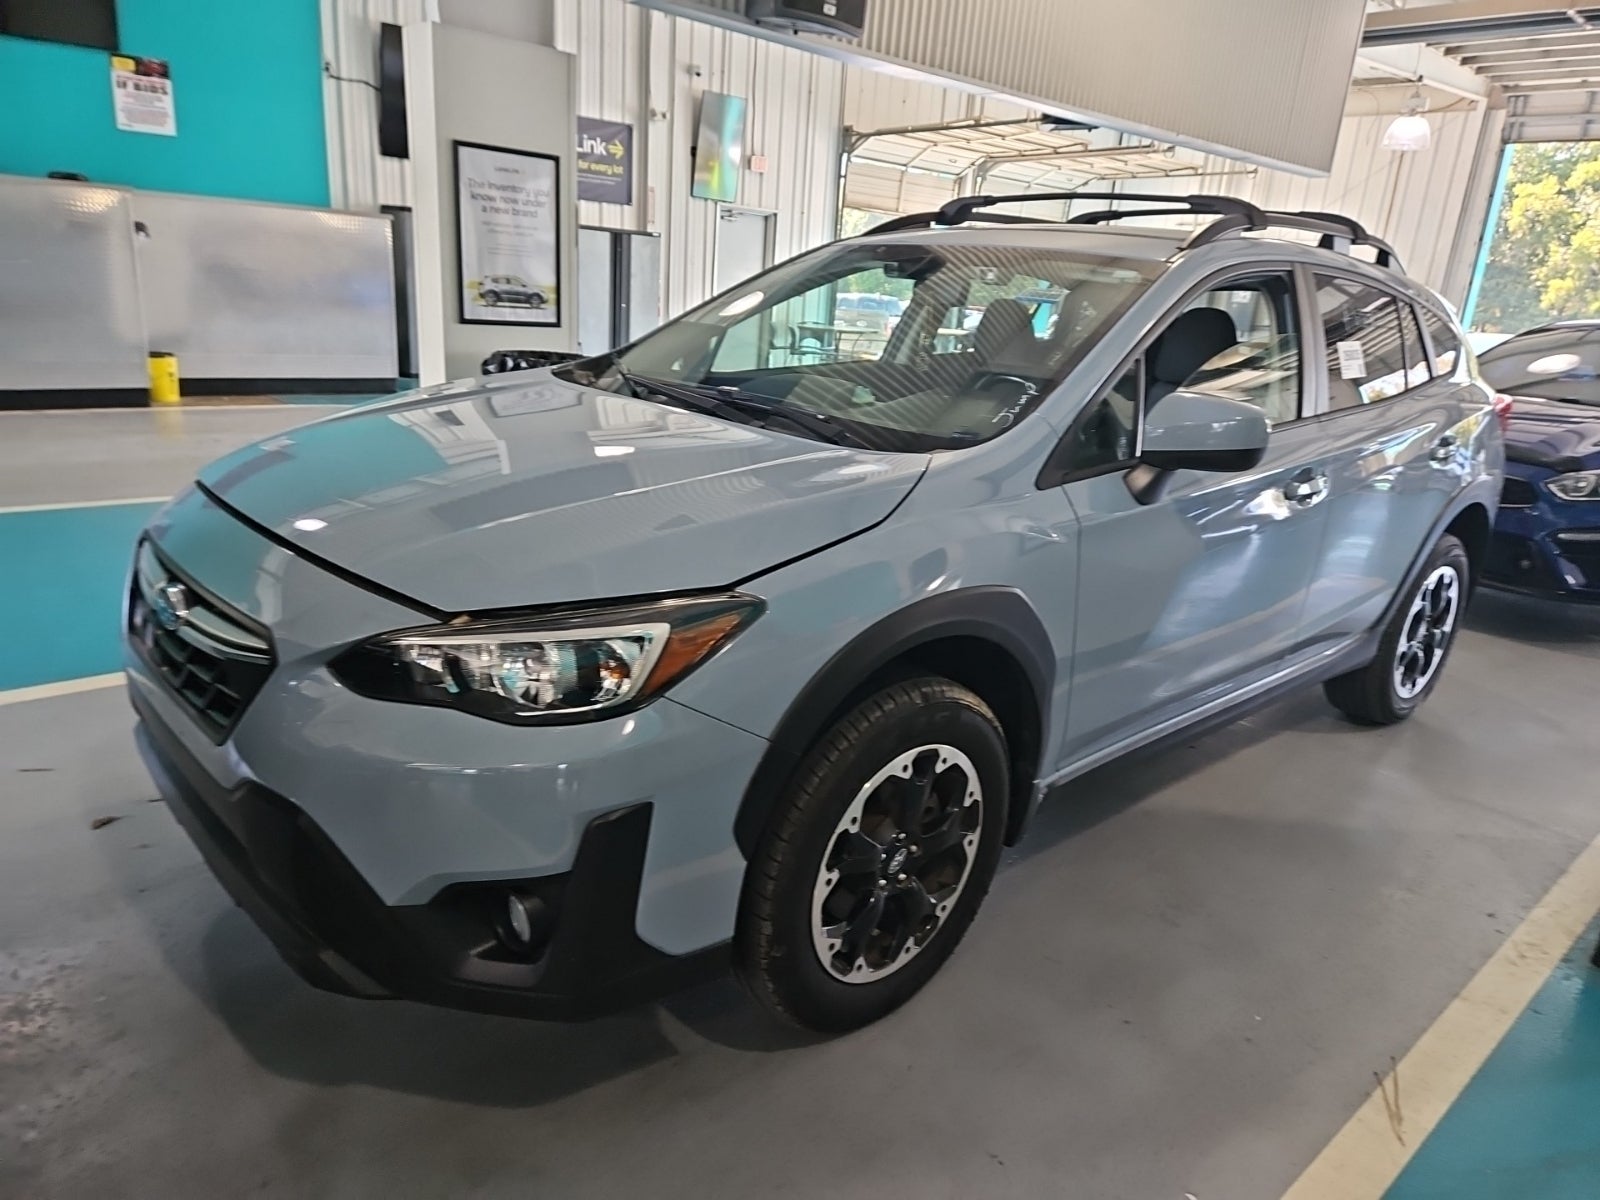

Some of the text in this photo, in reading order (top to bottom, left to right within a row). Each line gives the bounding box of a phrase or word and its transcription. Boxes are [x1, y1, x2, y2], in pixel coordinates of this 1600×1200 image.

[589, 162, 612, 175] every
[467, 177, 485, 188] The
[470, 190, 546, 208] know now under
[481, 205, 539, 218] a new brand
